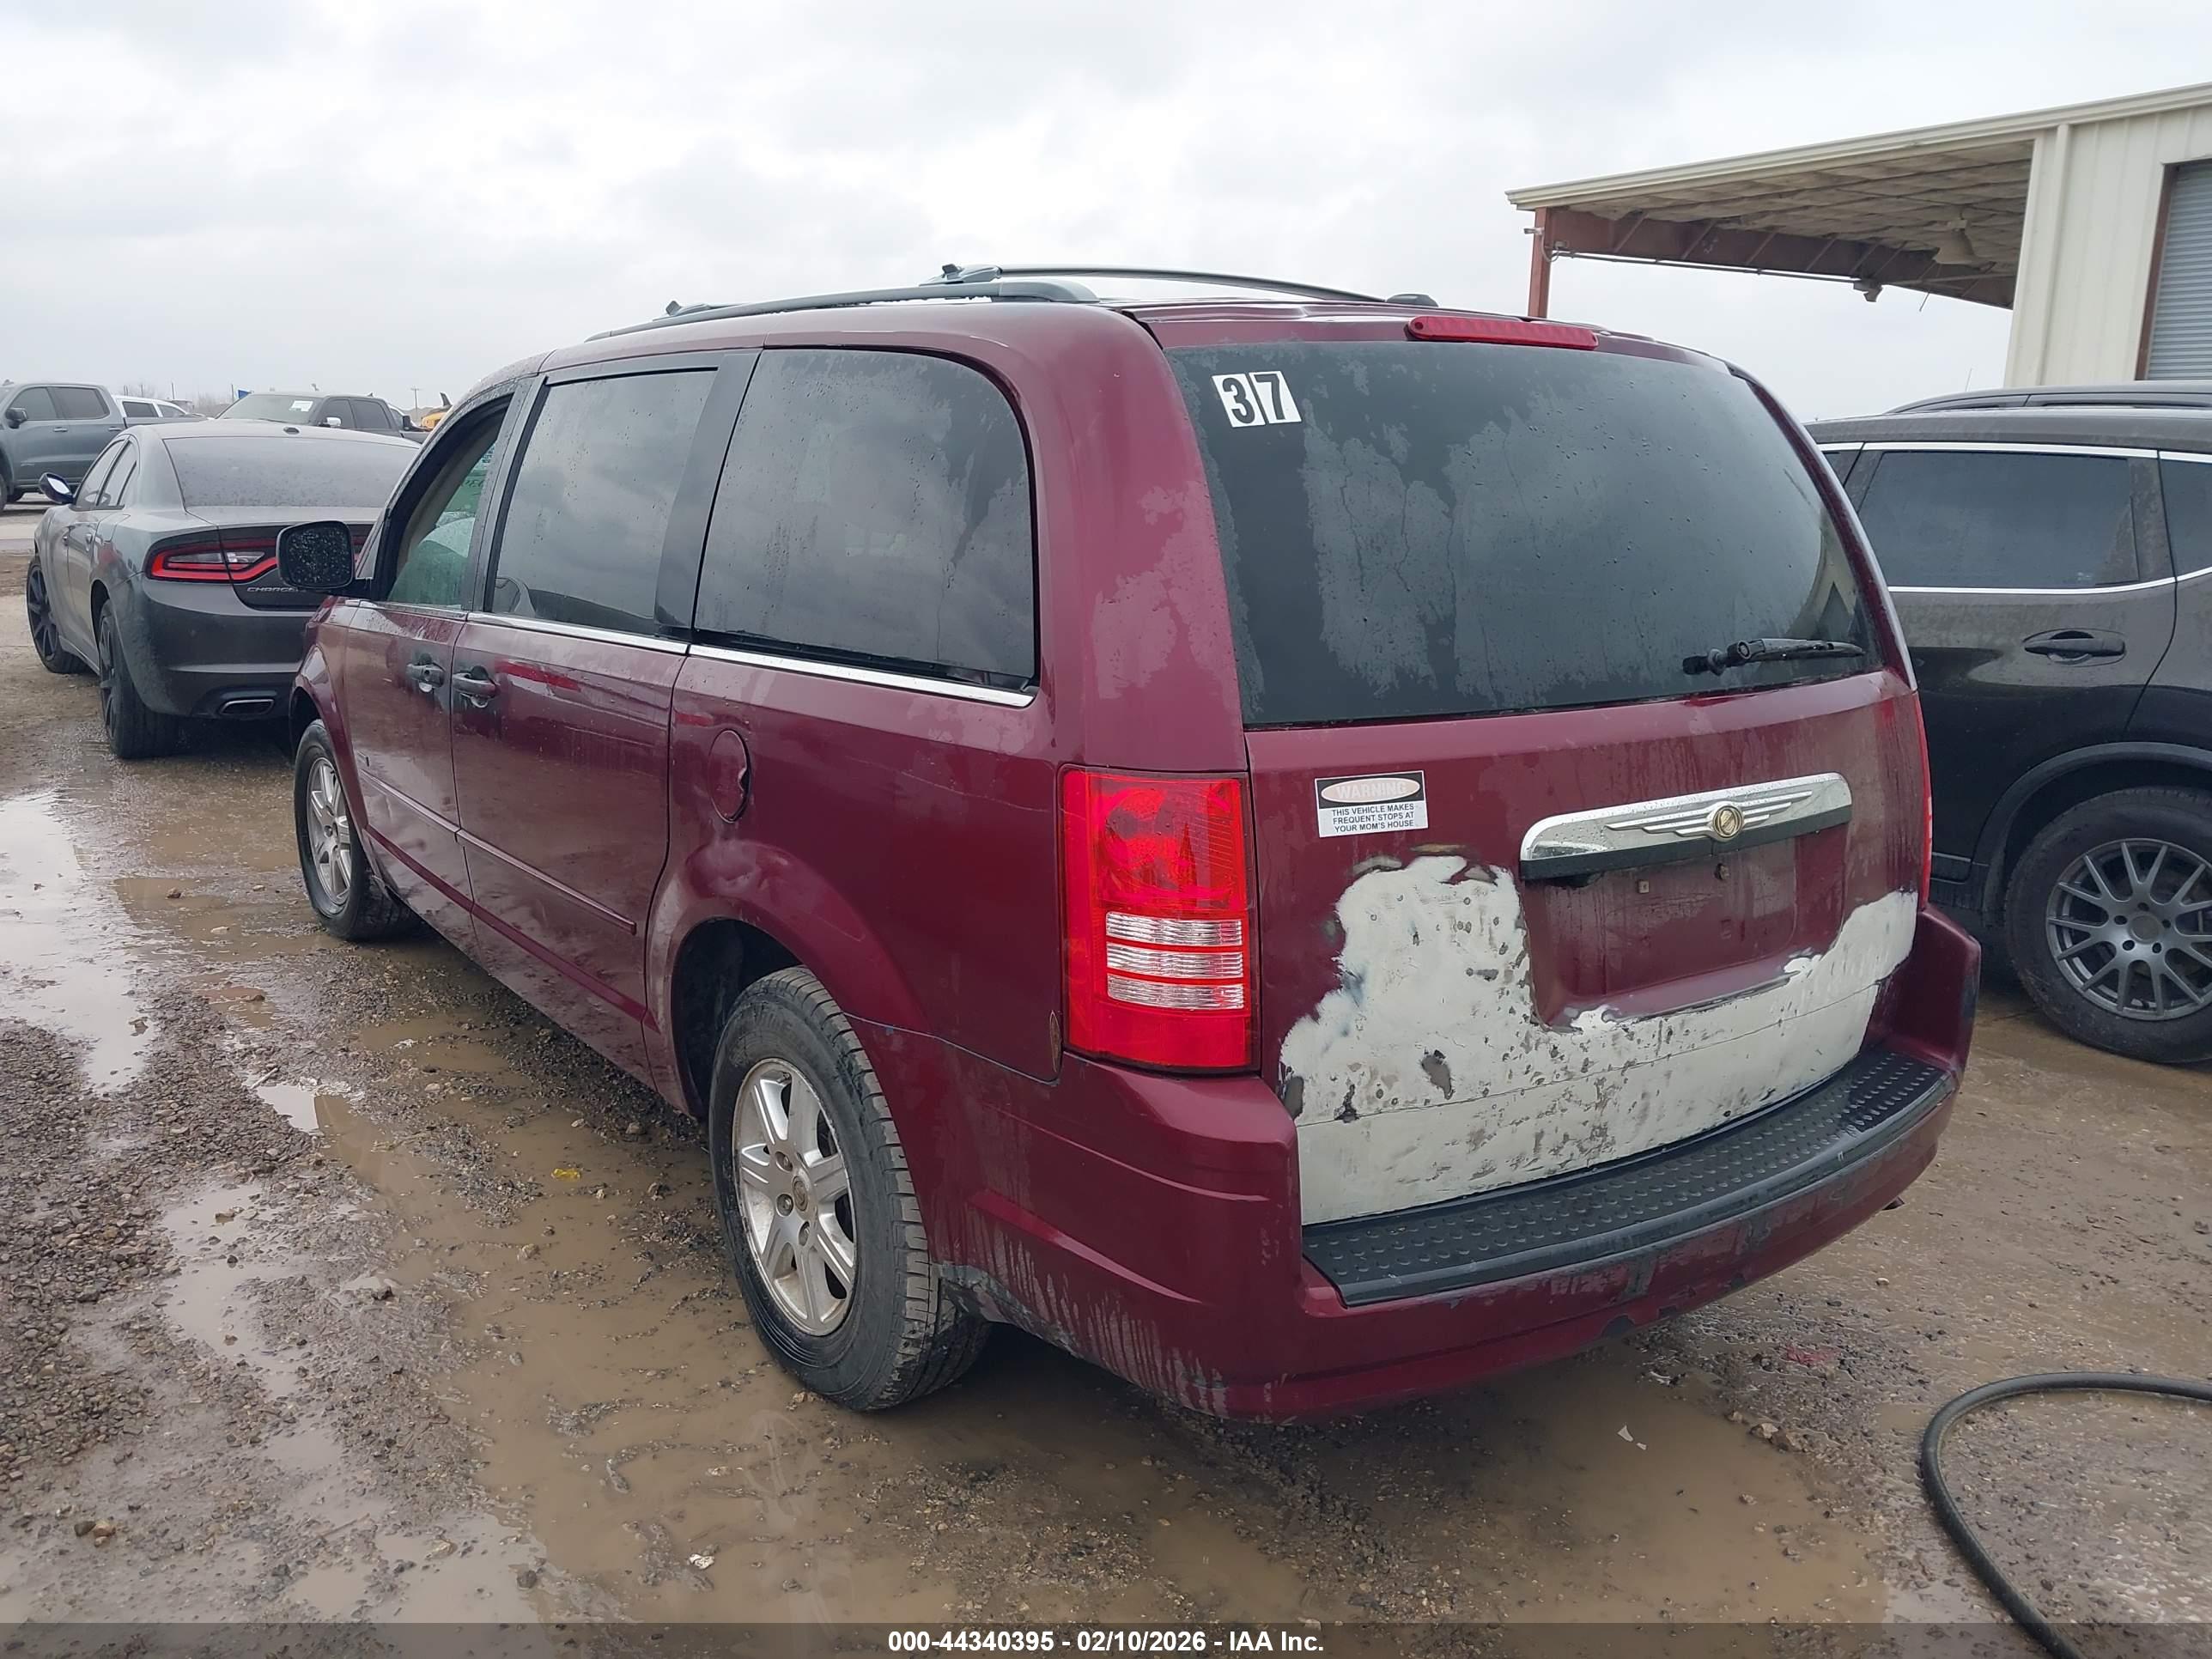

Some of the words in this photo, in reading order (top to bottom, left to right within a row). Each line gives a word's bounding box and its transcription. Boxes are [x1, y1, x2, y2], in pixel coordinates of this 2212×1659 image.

[1221, 373, 1286, 424] 37
[1336, 781, 1407, 799] WARNING
[1352, 805, 1386, 814] VEHICLE
[1333, 815, 1376, 825] FREQUENT
[1377, 812, 1403, 822] STOPS
[1359, 822, 1386, 830] MOM'S
[1387, 819, 1414, 828] HOUSE
